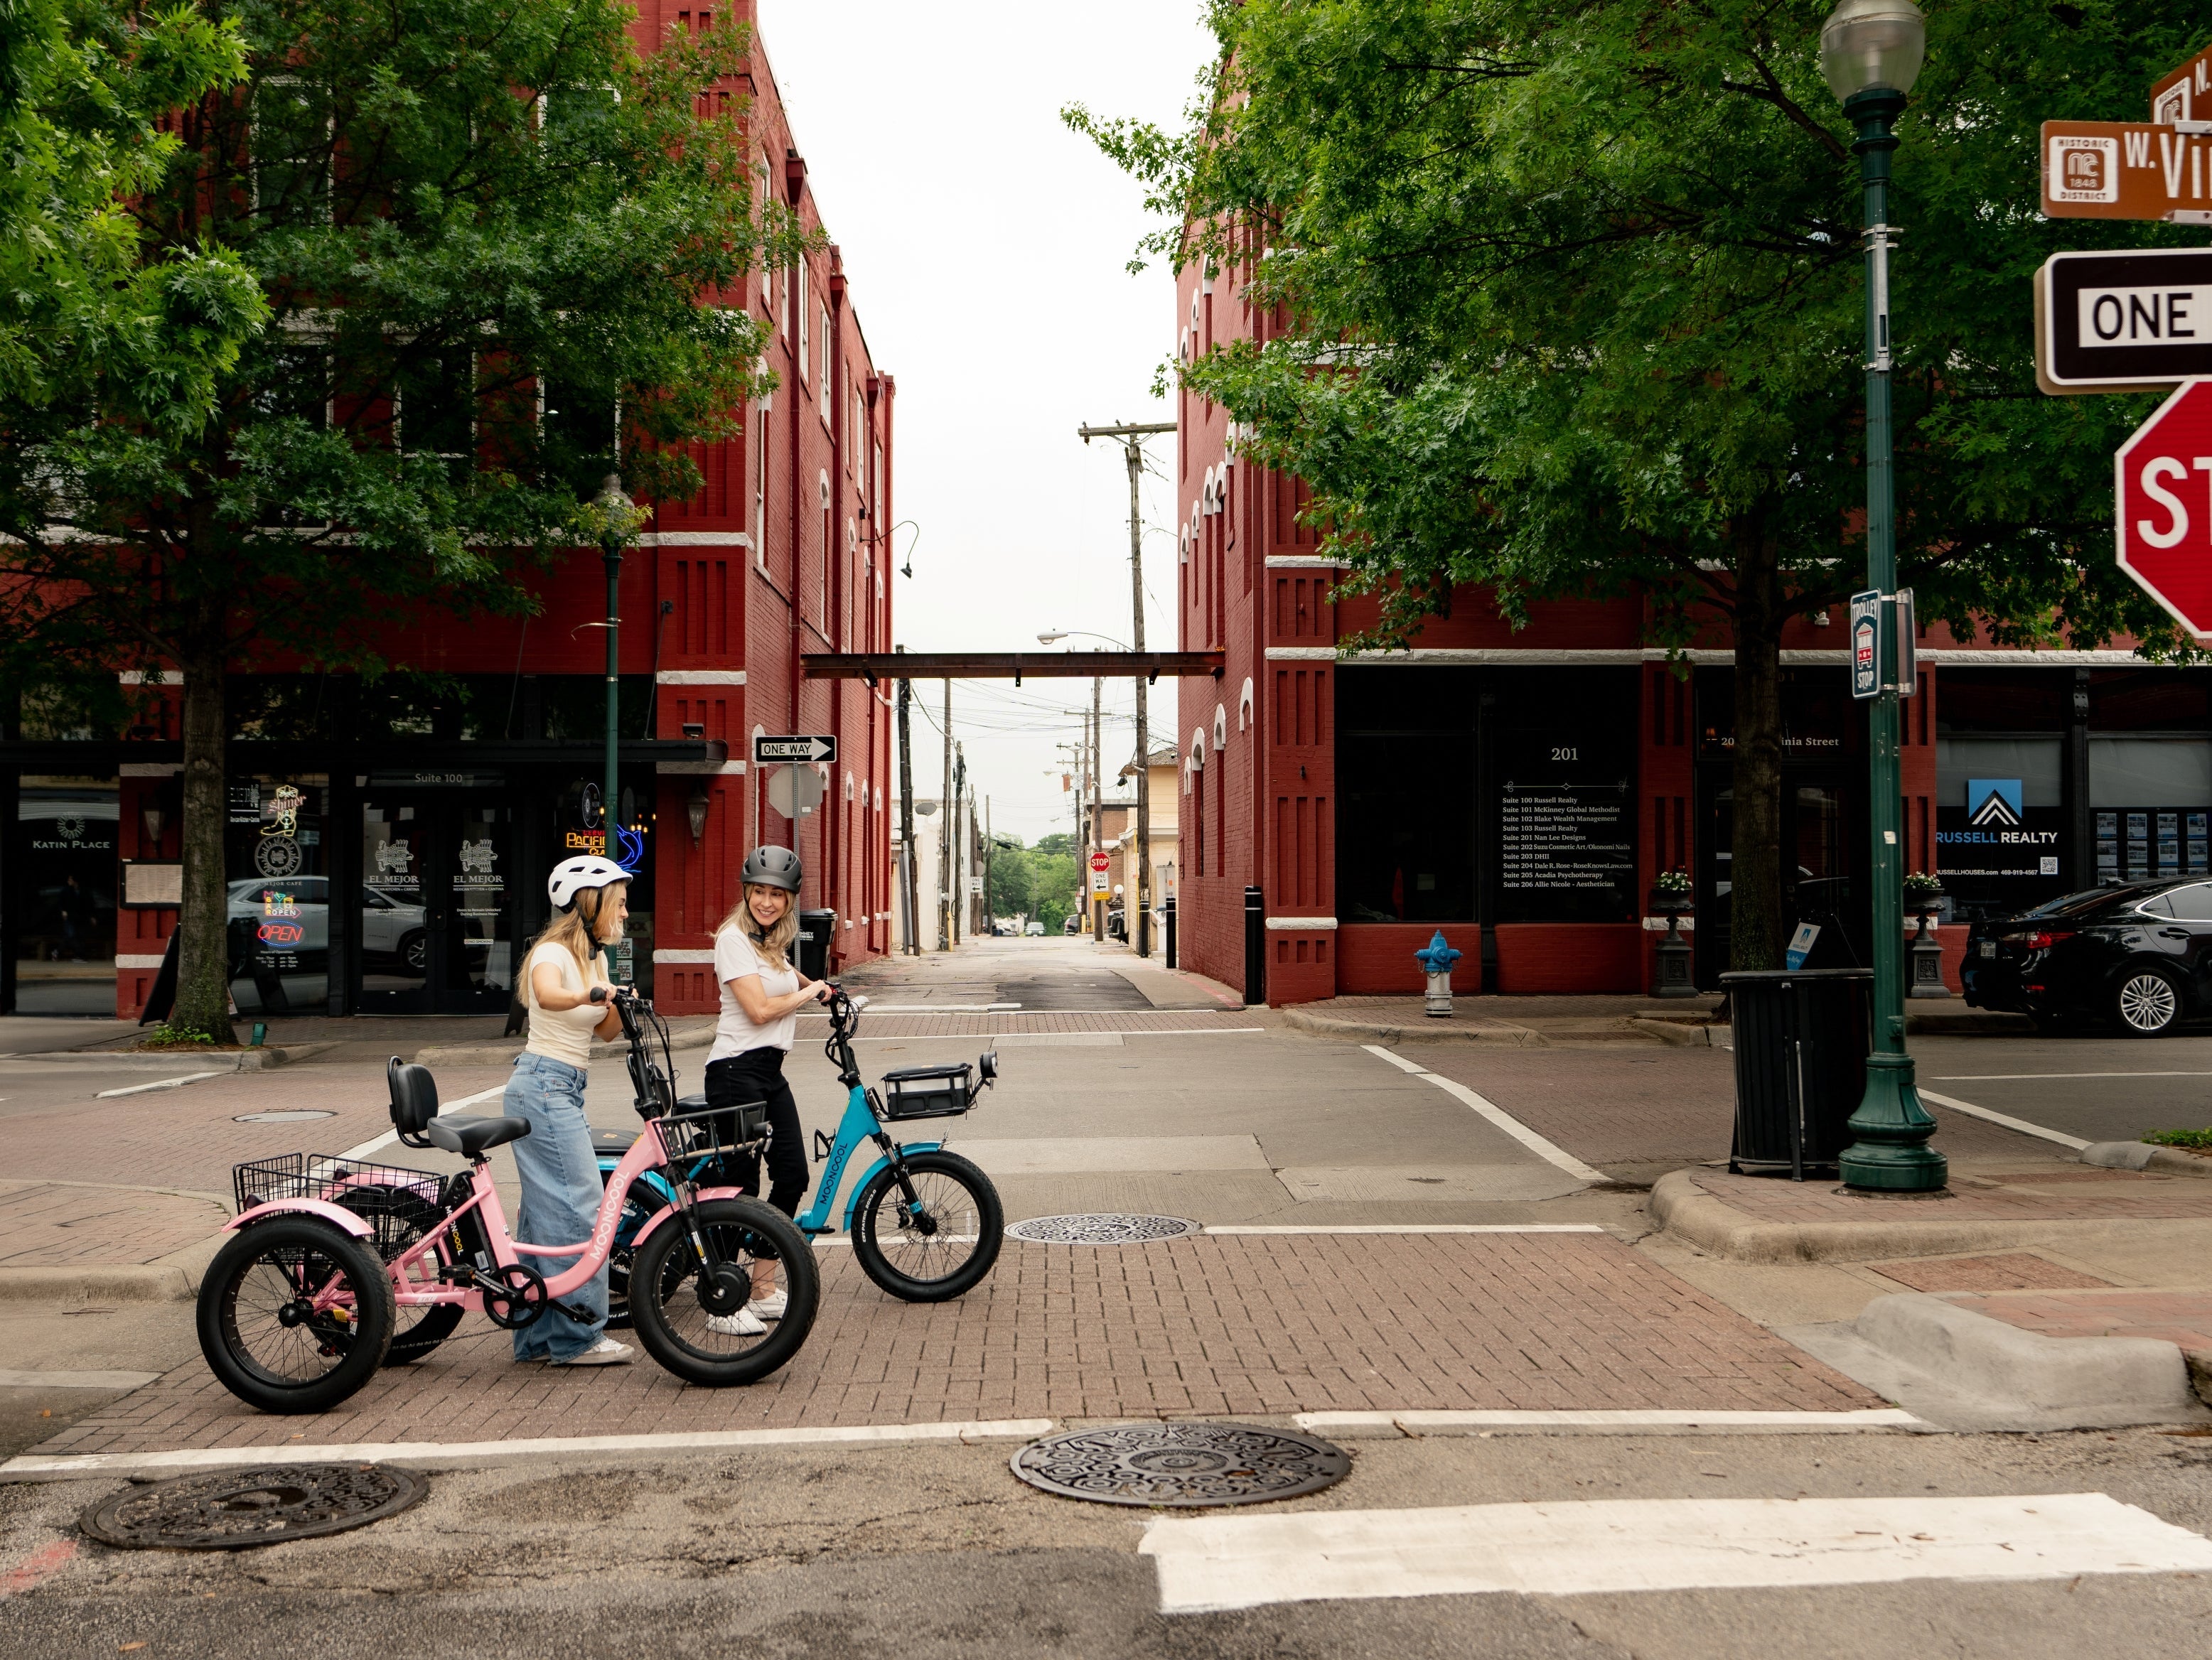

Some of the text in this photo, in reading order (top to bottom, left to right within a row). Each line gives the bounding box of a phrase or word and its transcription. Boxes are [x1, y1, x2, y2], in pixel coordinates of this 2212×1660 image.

[2195, 58, 2211, 97] N.
[2058, 139, 2109, 148] HISTORIC
[2123, 131, 2212, 199] W. Vi
[2070, 178, 2098, 188] 1848
[2061, 191, 2107, 200] DISTRICT
[2092, 293, 2195, 340] ONE
[2137, 456, 2212, 549] ST
[1852, 599, 1878, 626] TROLLEY
[1857, 671, 1874, 689] STOP
[1805, 737, 1838, 746] Street
[764, 744, 811, 754] ONE WAY
[1552, 748, 1578, 760] 201
[414, 773, 462, 782] Suite 100
[268, 794, 307, 814] Shiner
[1936, 831, 2058, 844] RUSSELL REALTY
[1091, 858, 1109, 866] STOP
[369, 875, 420, 885] EL MEJOR
[453, 875, 504, 885] EL MEJOR
[1557, 871, 1604, 880] Psychotherapy
[257, 925, 304, 942] OPEN
[820, 1143, 848, 1204] MOONCOOL
[589, 1171, 630, 1261] MOONCOOL
